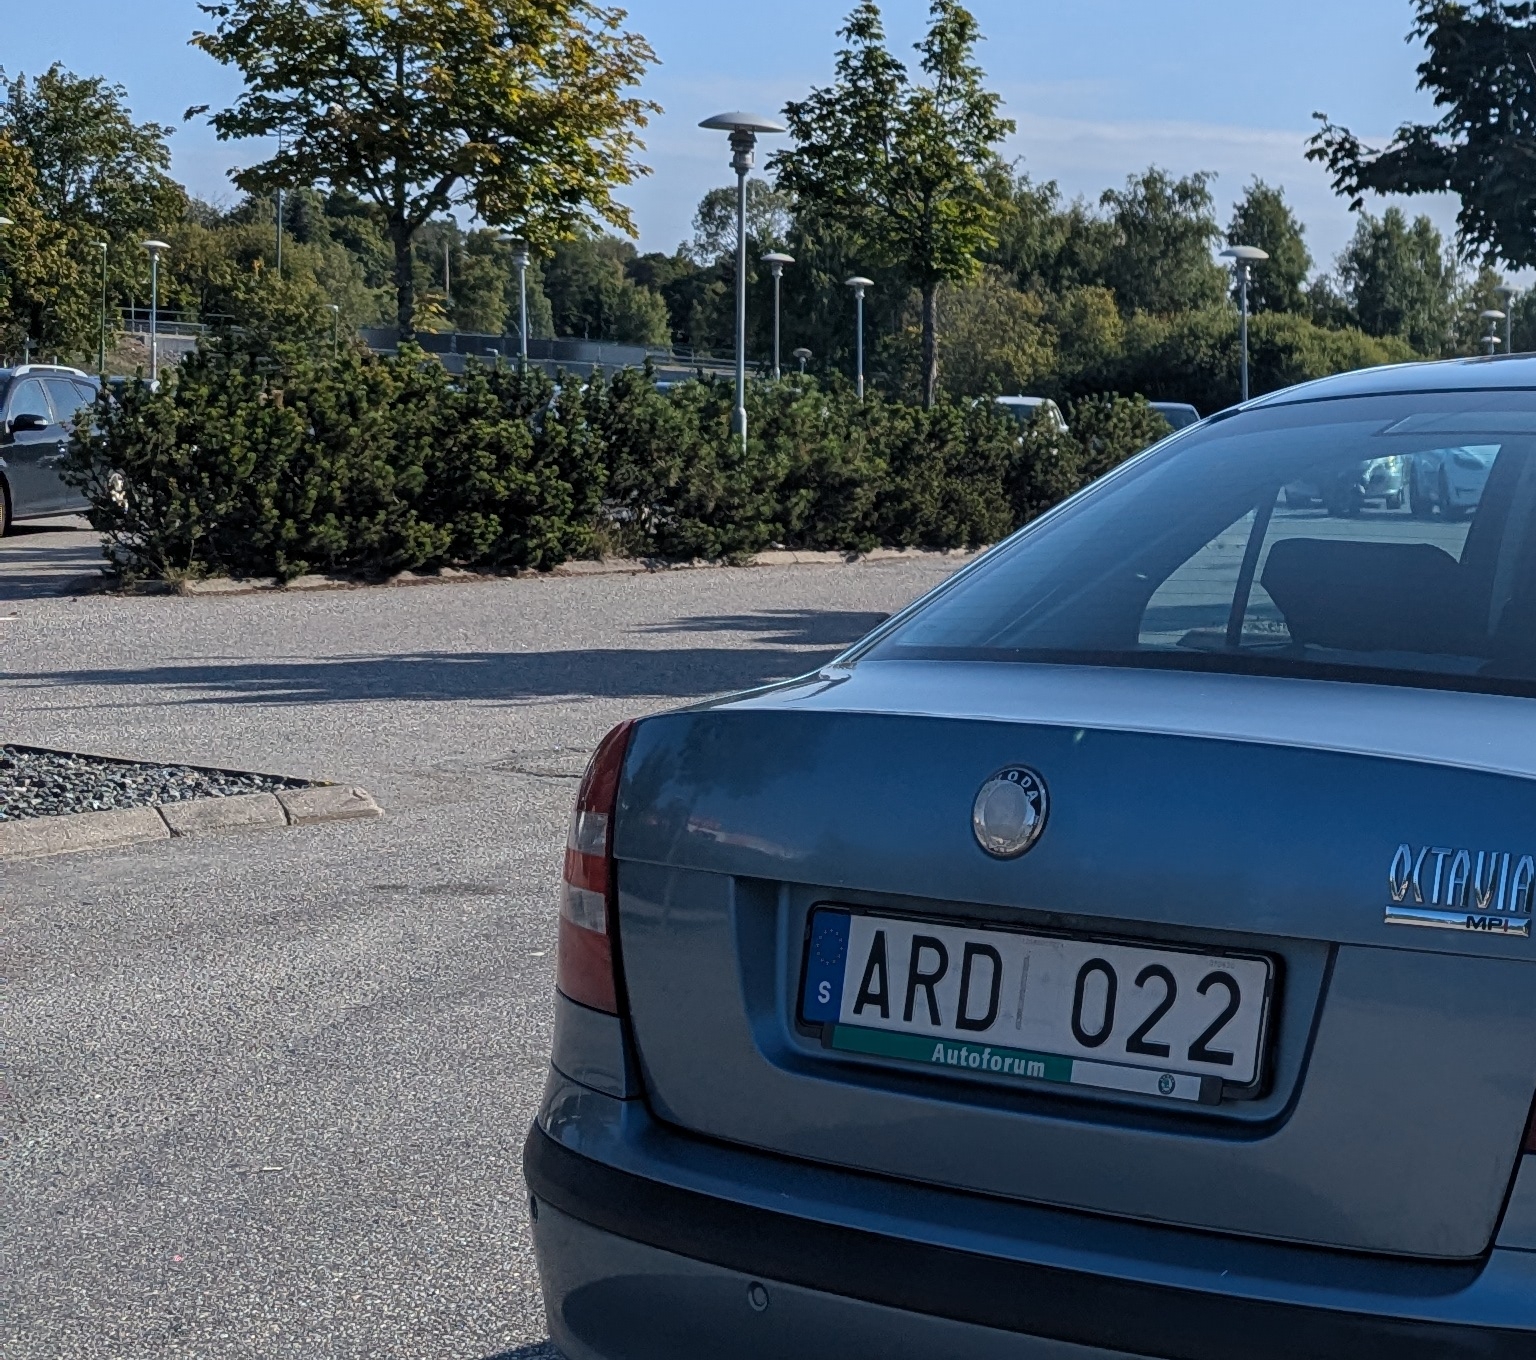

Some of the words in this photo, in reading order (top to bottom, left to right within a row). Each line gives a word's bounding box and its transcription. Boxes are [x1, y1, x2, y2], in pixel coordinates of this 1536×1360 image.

[1389, 843, 1536, 914] OCTAVIA
[1465, 915, 1509, 933] MPI
[816, 980, 832, 1005] S
[852, 930, 1003, 1032] ARD
[1071, 957, 1242, 1066] 022
[931, 1043, 1046, 1078] Autoforum
